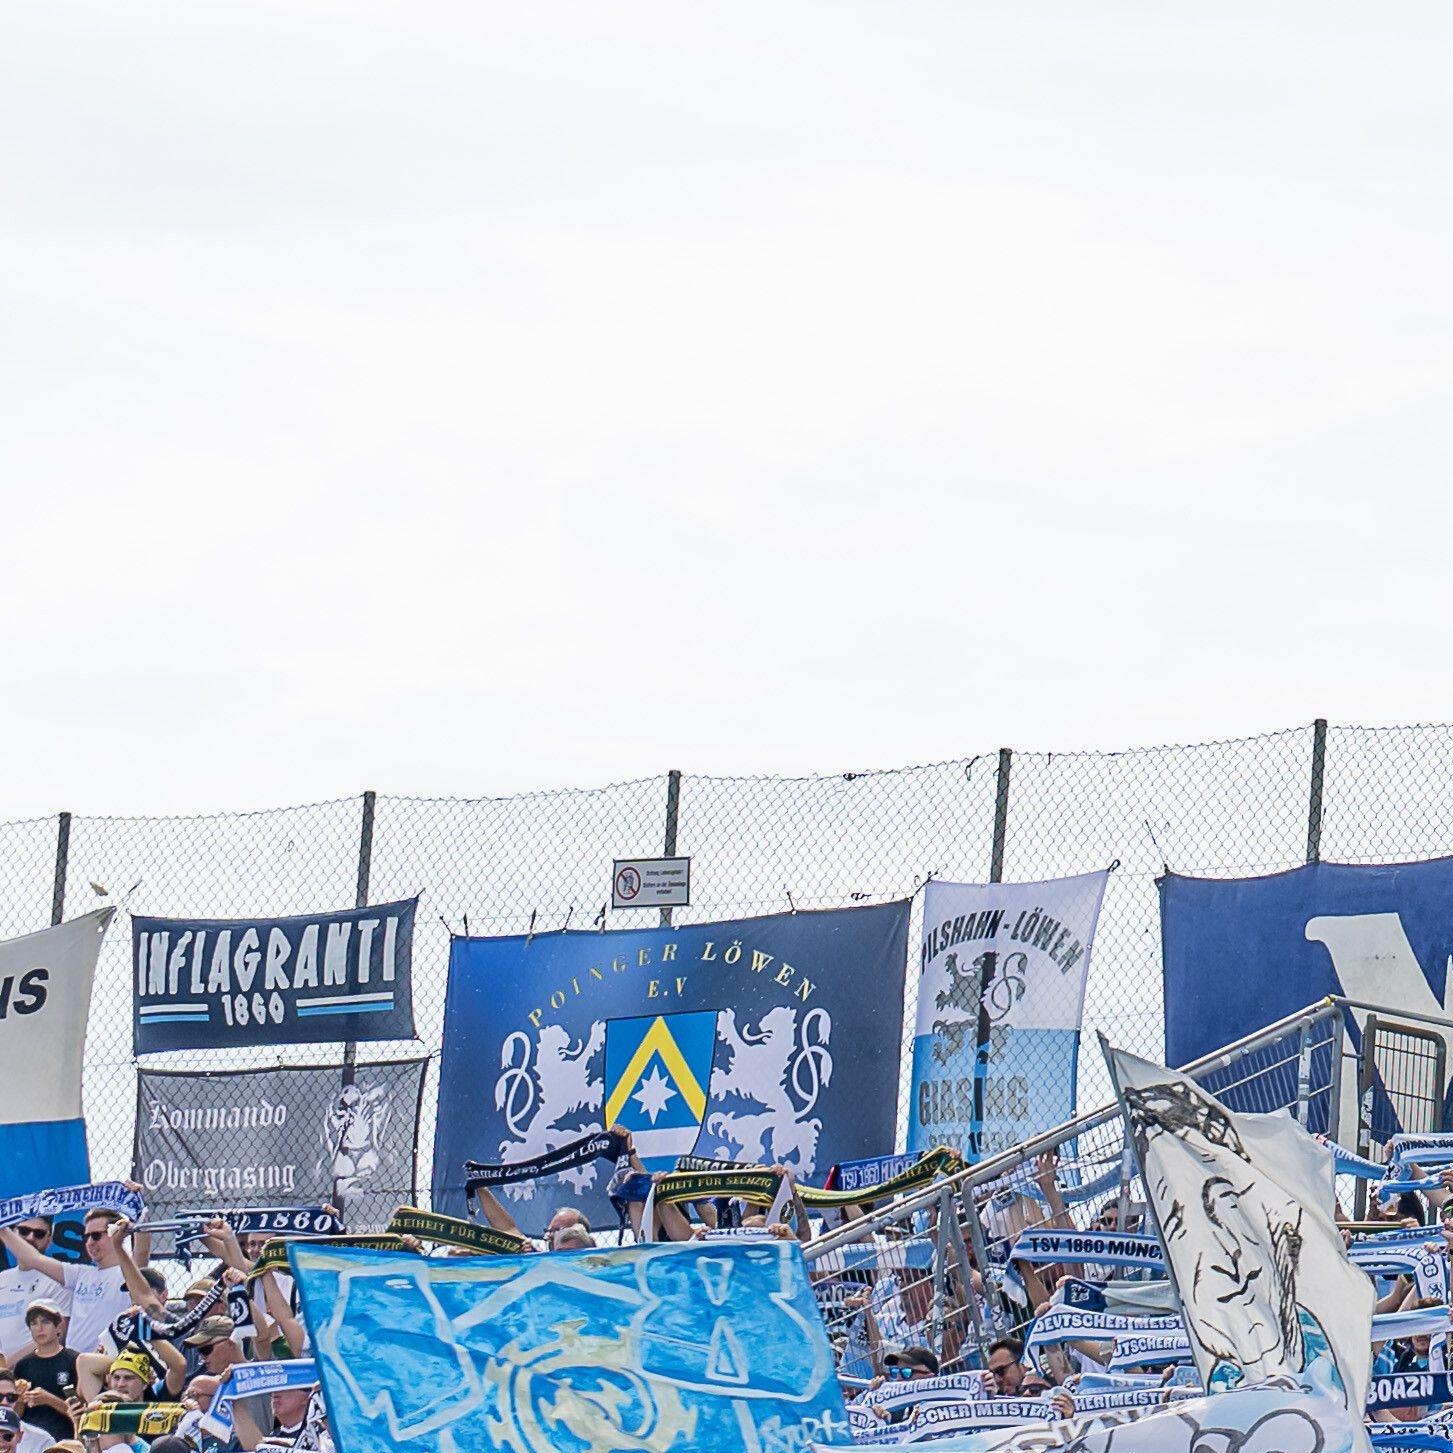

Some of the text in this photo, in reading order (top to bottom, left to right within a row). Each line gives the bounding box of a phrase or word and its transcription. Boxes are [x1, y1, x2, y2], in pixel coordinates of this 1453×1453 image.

[139, 916, 398, 996] INFLAGRANTI
[529, 935, 816, 1028] POINGER LÖWEN
[222, 991, 286, 1027] 1860
[148, 1099, 288, 1132] Kommando
[144, 1158, 296, 1195] Obergiasing
[698, 1174, 774, 1191] FÜR SECHZIG
[257, 1208, 333, 1234] 1860
[1030, 1237, 1105, 1257] TSV 1860
[1034, 1310, 1126, 1333] DEUTSCHER
[1368, 1375, 1434, 1400] BOAZN
[974, 1398, 1048, 1420] MEISTER
